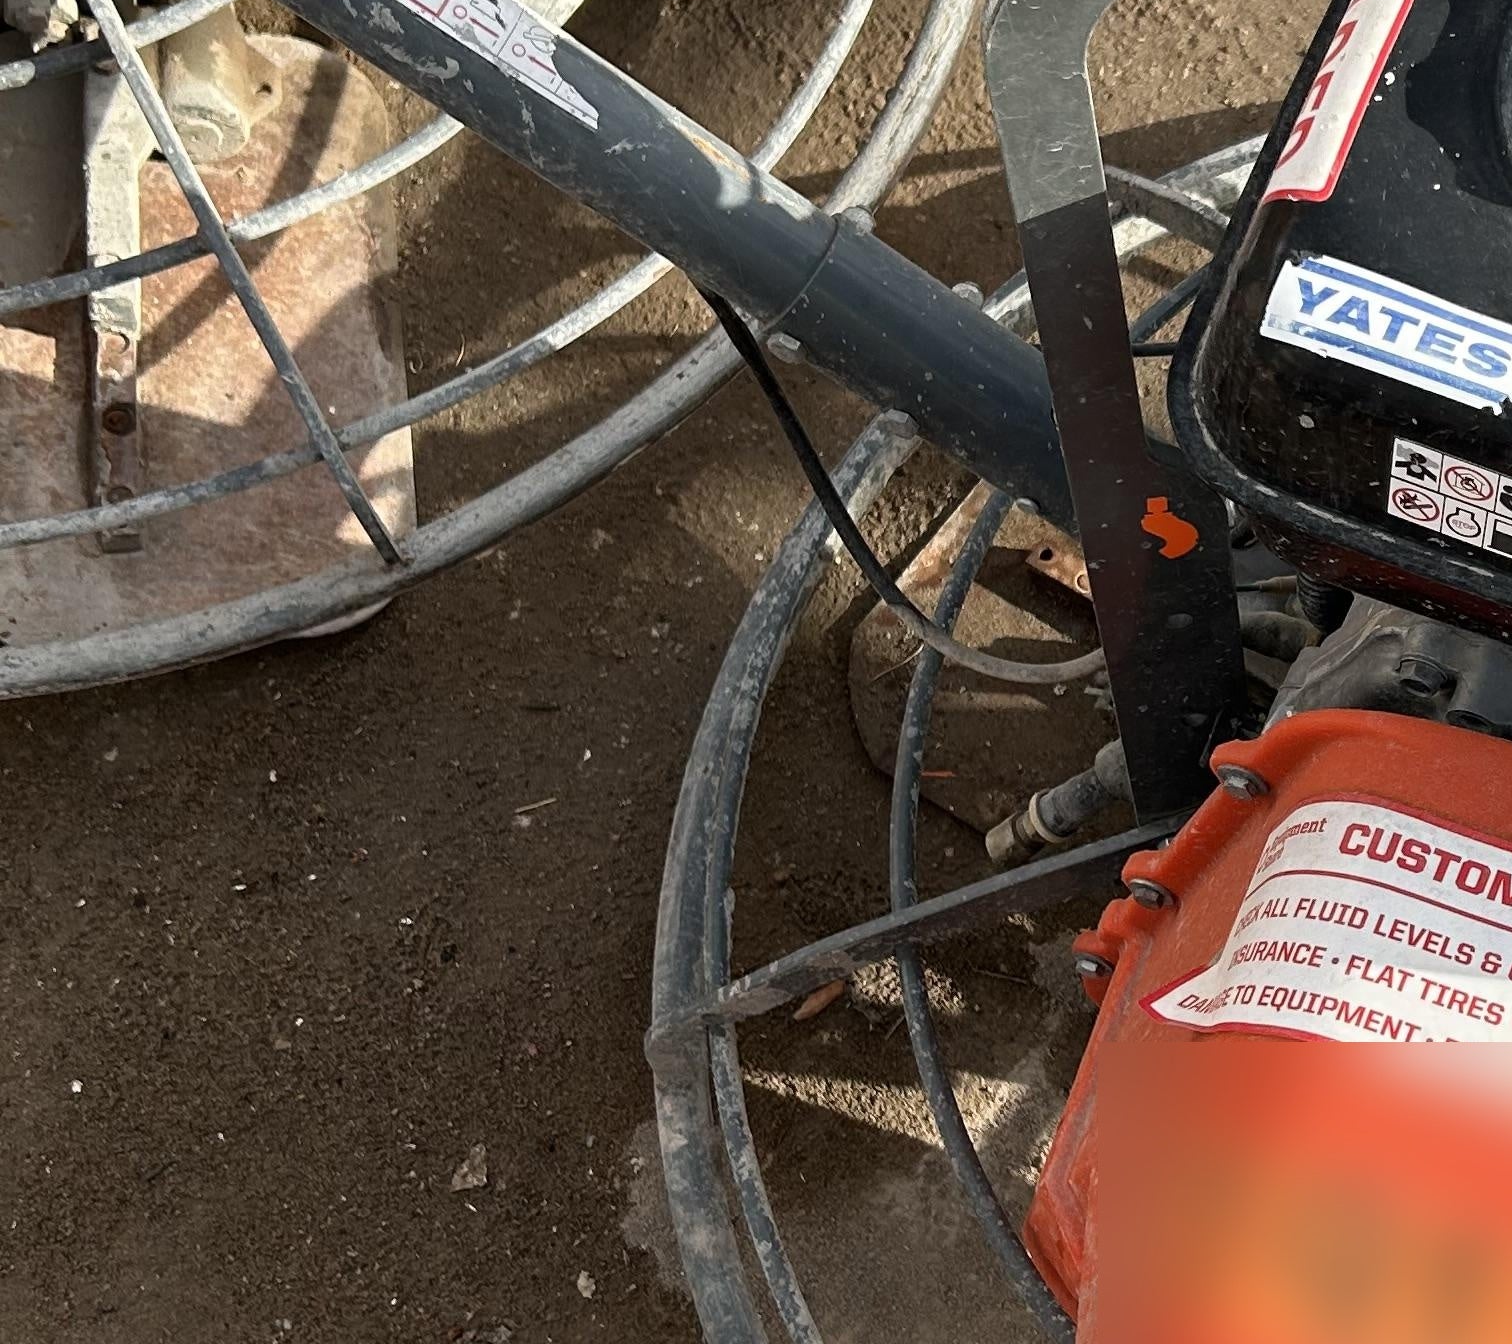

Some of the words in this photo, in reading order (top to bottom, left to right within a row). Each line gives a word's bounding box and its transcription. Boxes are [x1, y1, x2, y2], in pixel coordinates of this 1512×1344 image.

[1297, 277, 1512, 378] YATES
[1260, 898, 1290, 920] ALL
[1293, 898, 1369, 930] FLUID
[1373, 914, 1475, 966] LEVELS
[1481, 952, 1503, 977] &
[1233, 984, 1256, 1006] TO
[1257, 985, 1422, 1042] EQUIPMENT
[1344, 955, 1415, 993] FLAT
[1420, 977, 1506, 1027] TIRES
